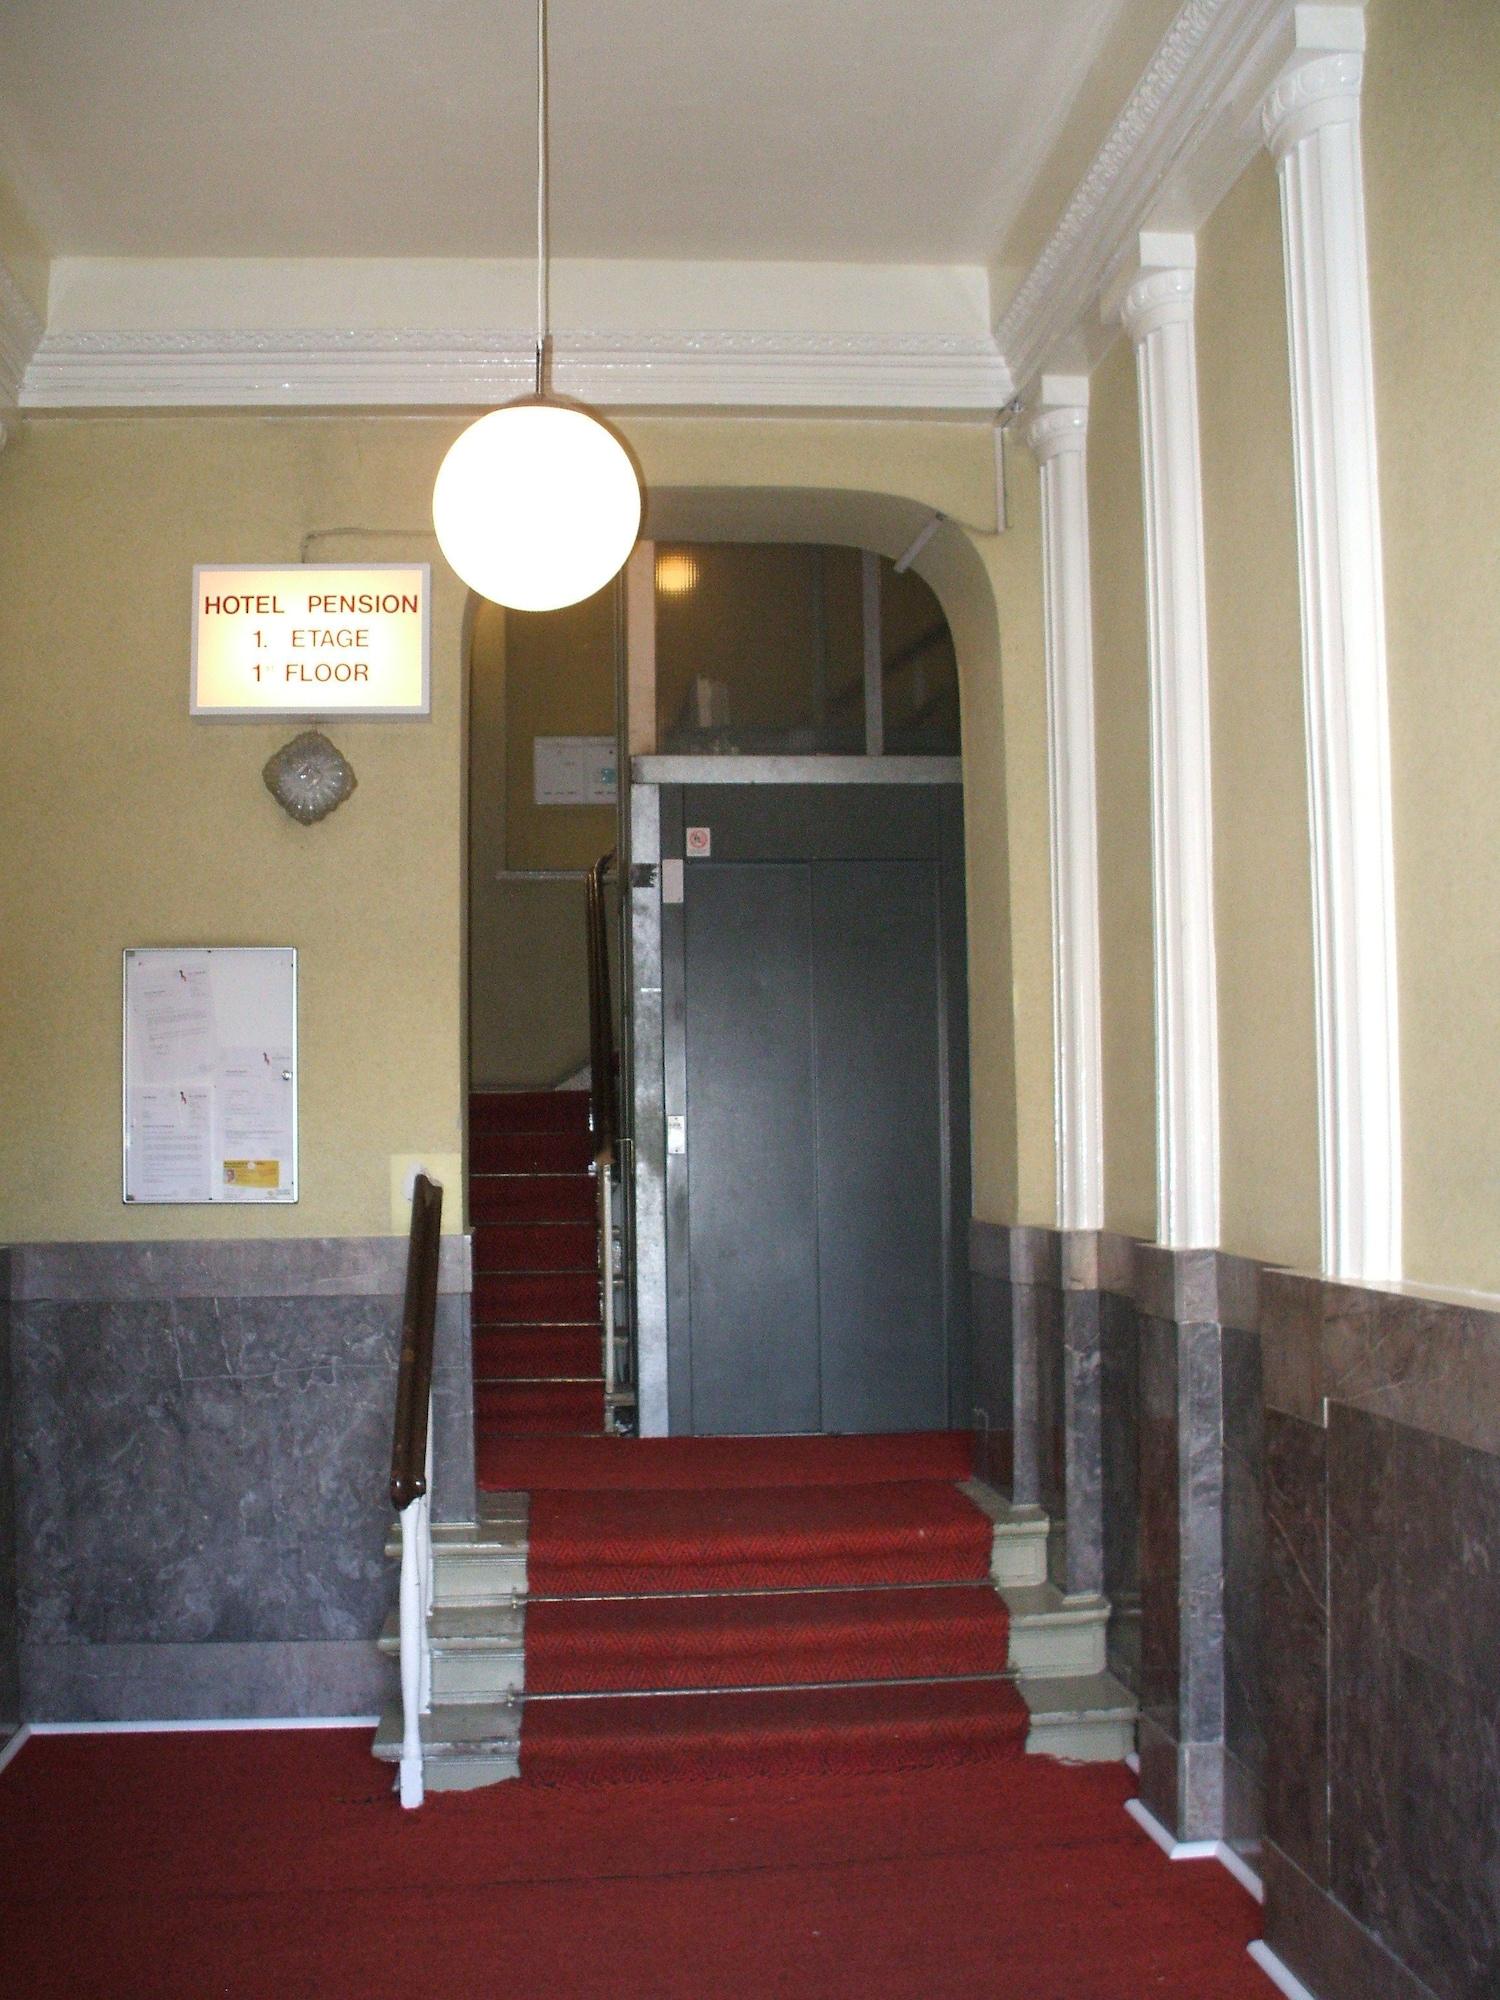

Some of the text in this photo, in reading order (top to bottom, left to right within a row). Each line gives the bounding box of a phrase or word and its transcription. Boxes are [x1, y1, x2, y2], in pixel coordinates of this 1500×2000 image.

[204, 594, 418, 615] HOTEL PENSION
[253, 629, 369, 648] 1. ETAGE
[286, 663, 369, 682] FLOOR
